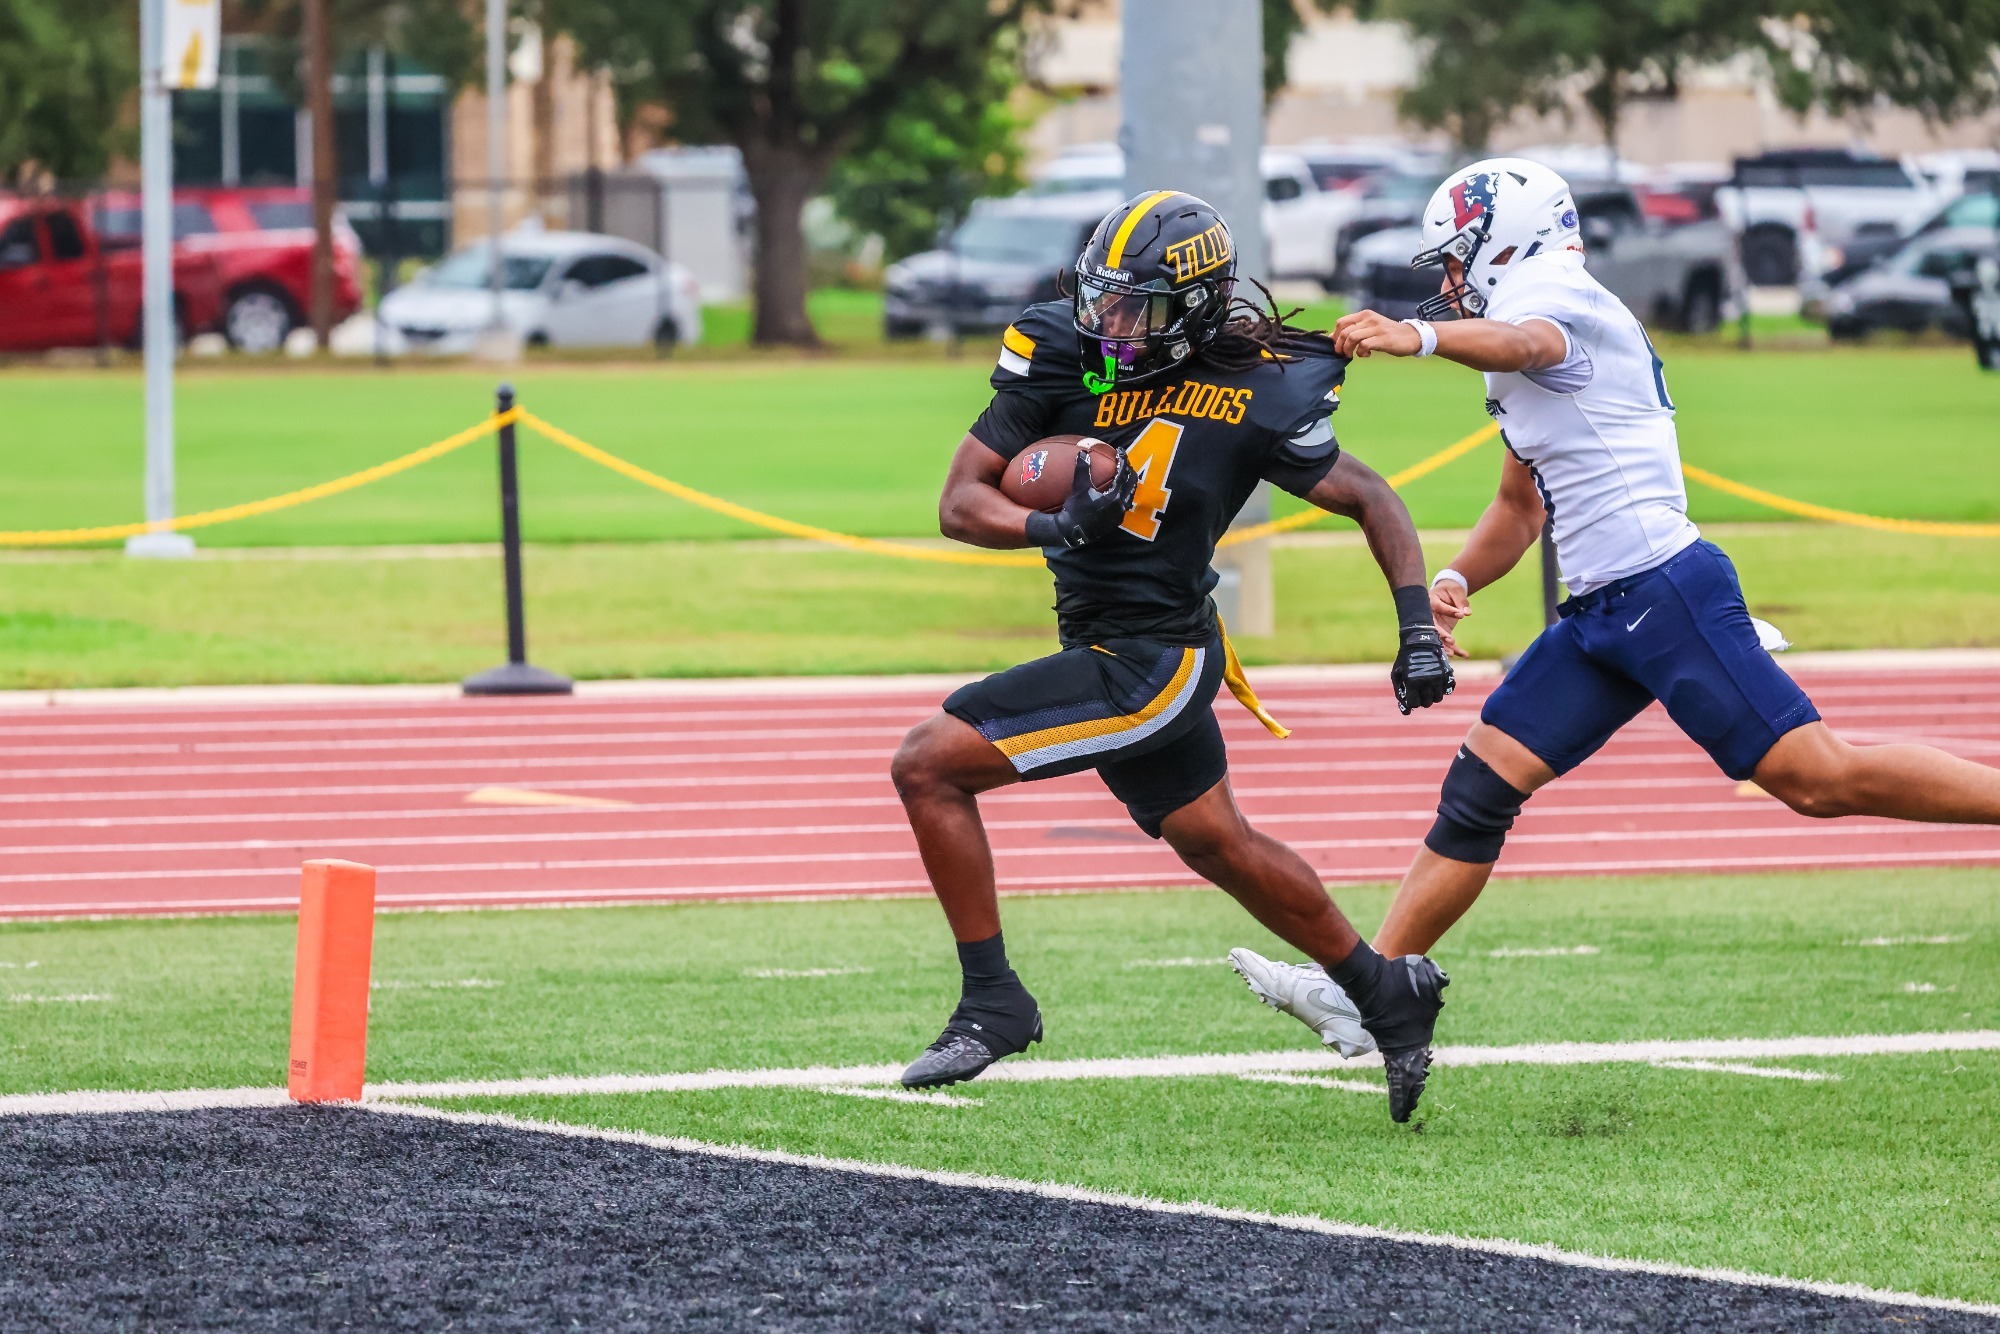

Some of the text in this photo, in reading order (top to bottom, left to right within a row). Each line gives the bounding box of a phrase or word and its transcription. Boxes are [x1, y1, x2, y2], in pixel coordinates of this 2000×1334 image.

[1096, 266, 1130, 282] Riddell
[1166, 222, 1231, 283] TLU
[1093, 380, 1253, 427] BULLDOGS
[1118, 417, 1185, 542] 4
